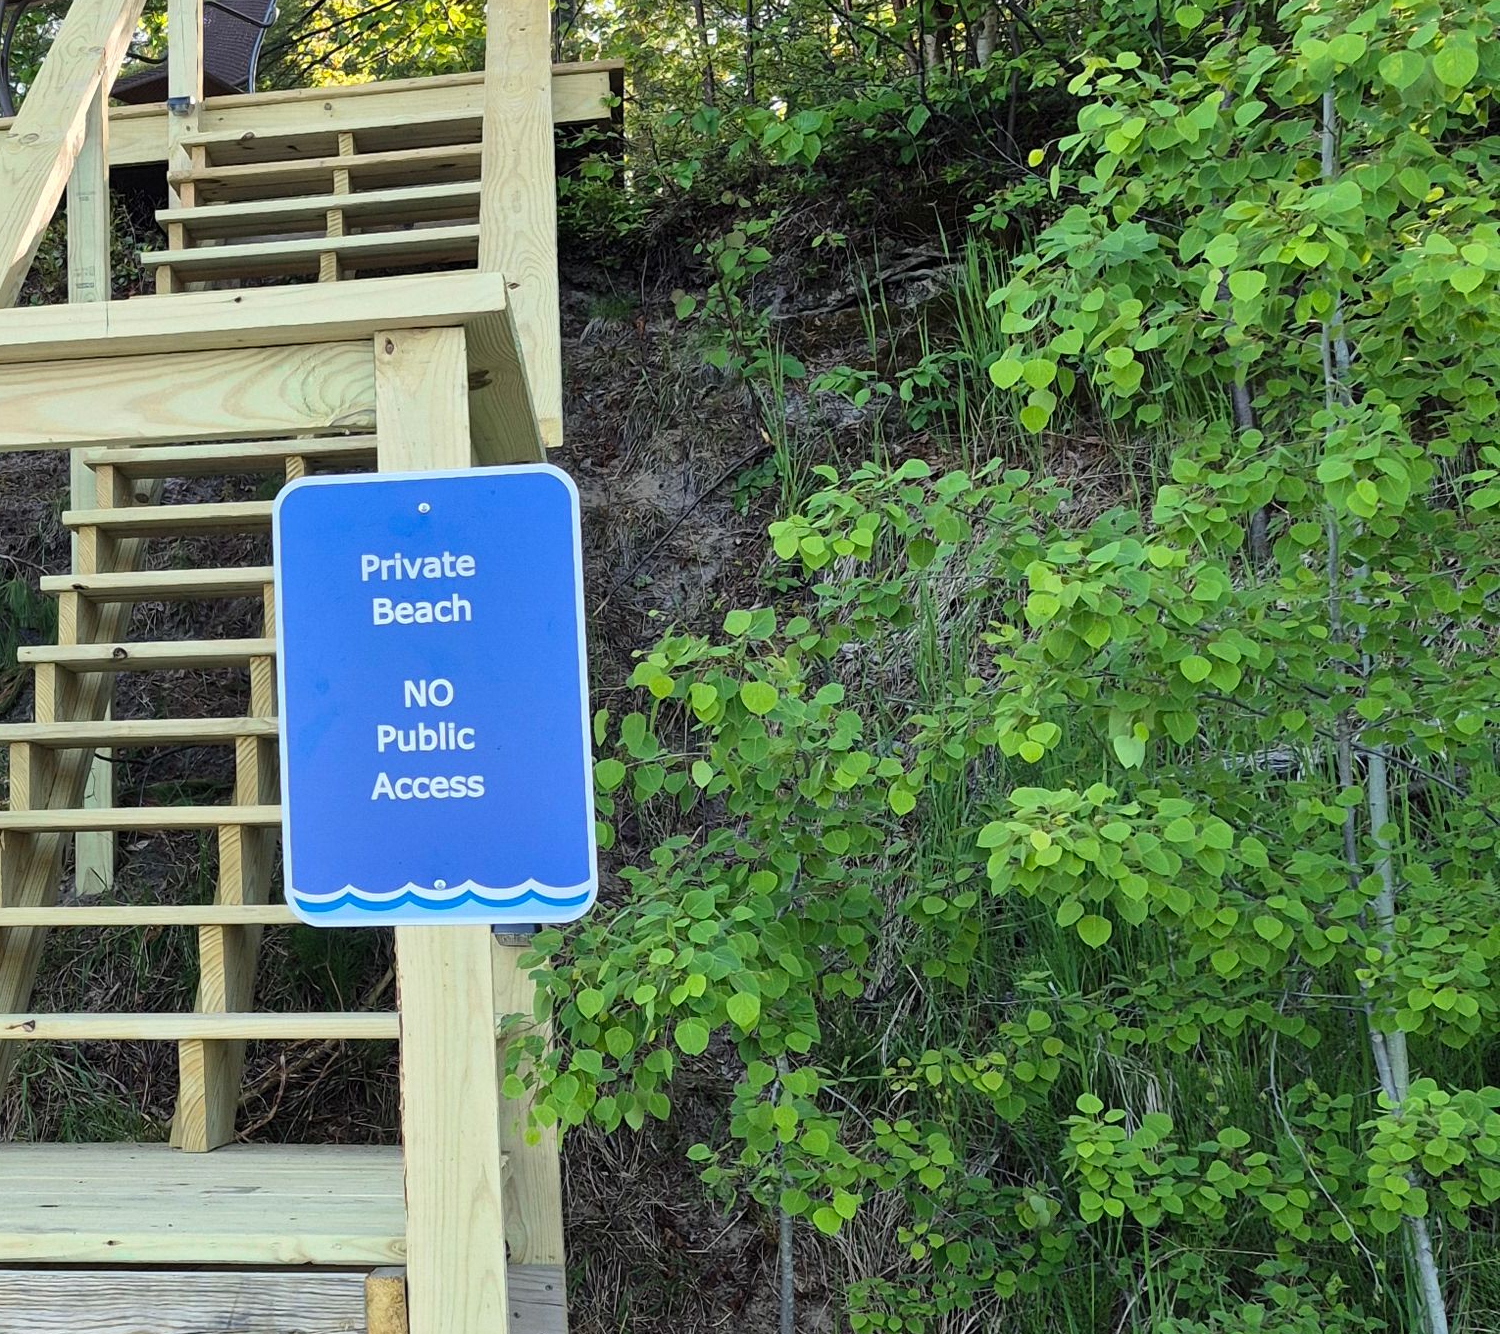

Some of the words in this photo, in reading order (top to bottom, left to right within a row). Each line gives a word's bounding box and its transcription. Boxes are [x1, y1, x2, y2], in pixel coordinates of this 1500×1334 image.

[361, 551, 476, 582] Private
[372, 593, 472, 626] Beach
[404, 678, 454, 708] NO
[377, 722, 476, 753] Public
[371, 772, 485, 801] Access
